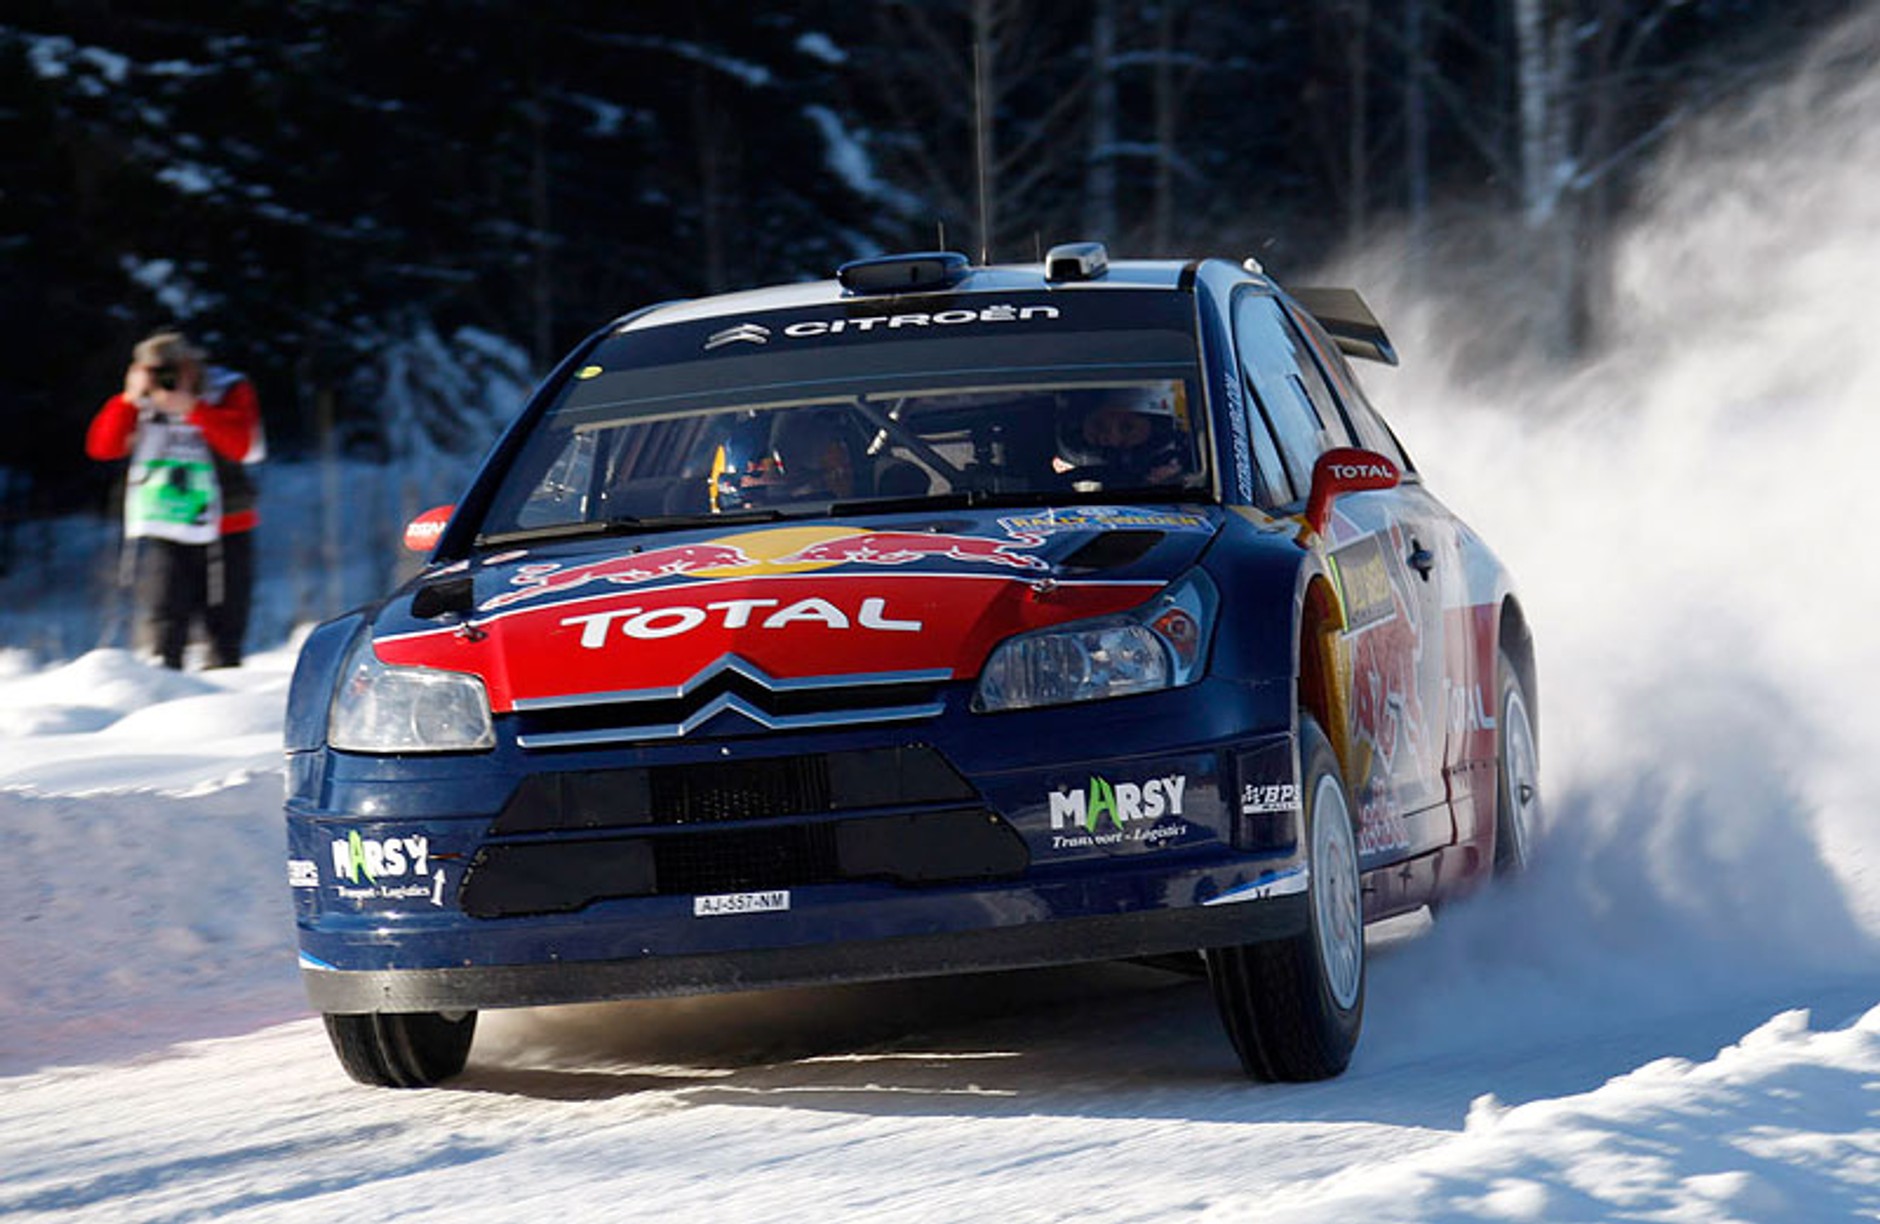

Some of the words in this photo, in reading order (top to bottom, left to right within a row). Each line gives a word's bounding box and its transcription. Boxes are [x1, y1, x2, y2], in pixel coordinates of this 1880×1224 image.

[1328, 465, 1392, 479] TOTAL
[561, 597, 922, 648] TOTAL
[1048, 775, 1186, 833] MARSY
[331, 829, 429, 884] MARSY
[701, 892, 784, 913] AJ-557-NM
